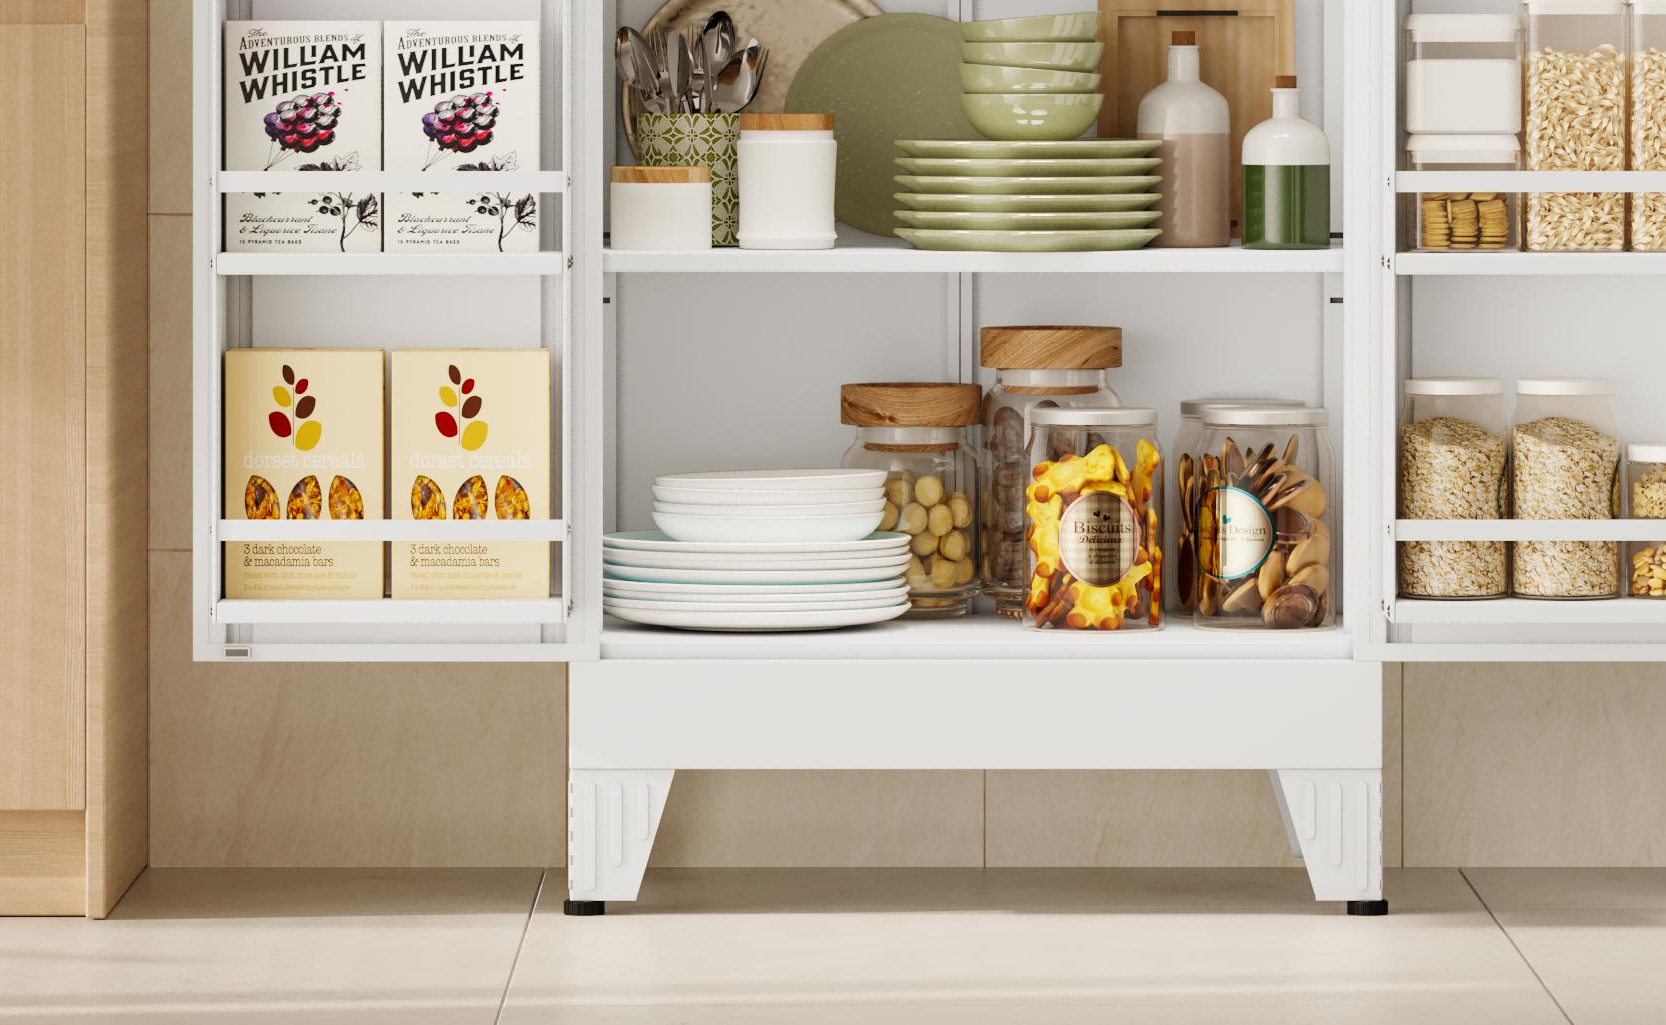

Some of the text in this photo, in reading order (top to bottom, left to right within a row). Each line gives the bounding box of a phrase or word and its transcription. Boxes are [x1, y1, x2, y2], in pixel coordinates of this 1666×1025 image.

[247, 27, 268, 38] The
[406, 27, 427, 38] The
[239, 36, 311, 50] ADVENTUROUS
[314, 34, 349, 43] BLENDS
[397, 36, 470, 50] ADVENTUROUS
[472, 34, 507, 43] BLENDS
[239, 43, 366, 77] WILLIAM
[397, 43, 524, 77] WILLIAM
[239, 63, 366, 104] WHISTLE
[397, 63, 524, 104] WHISTLE
[240, 213, 313, 223] Blackcurrant
[398, 213, 472, 223] Blackcurrant
[248, 224, 301, 236] Liquorice
[304, 224, 338, 234] Tisane
[407, 224, 459, 236] Liquorice
[462, 224, 496, 234] Tisane
[243, 451, 365, 469] dorset cereals
[410, 451, 532, 469] dorset cereals
[1074, 520, 1131, 534] Biscuits
[1229, 526, 1266, 536] Design
[243, 543, 322, 555] 3 dark chocolate
[410, 543, 488, 555] 3 dark chocolate
[243, 556, 334, 567] & macadamia bars
[410, 556, 500, 567] & macadamia bars
